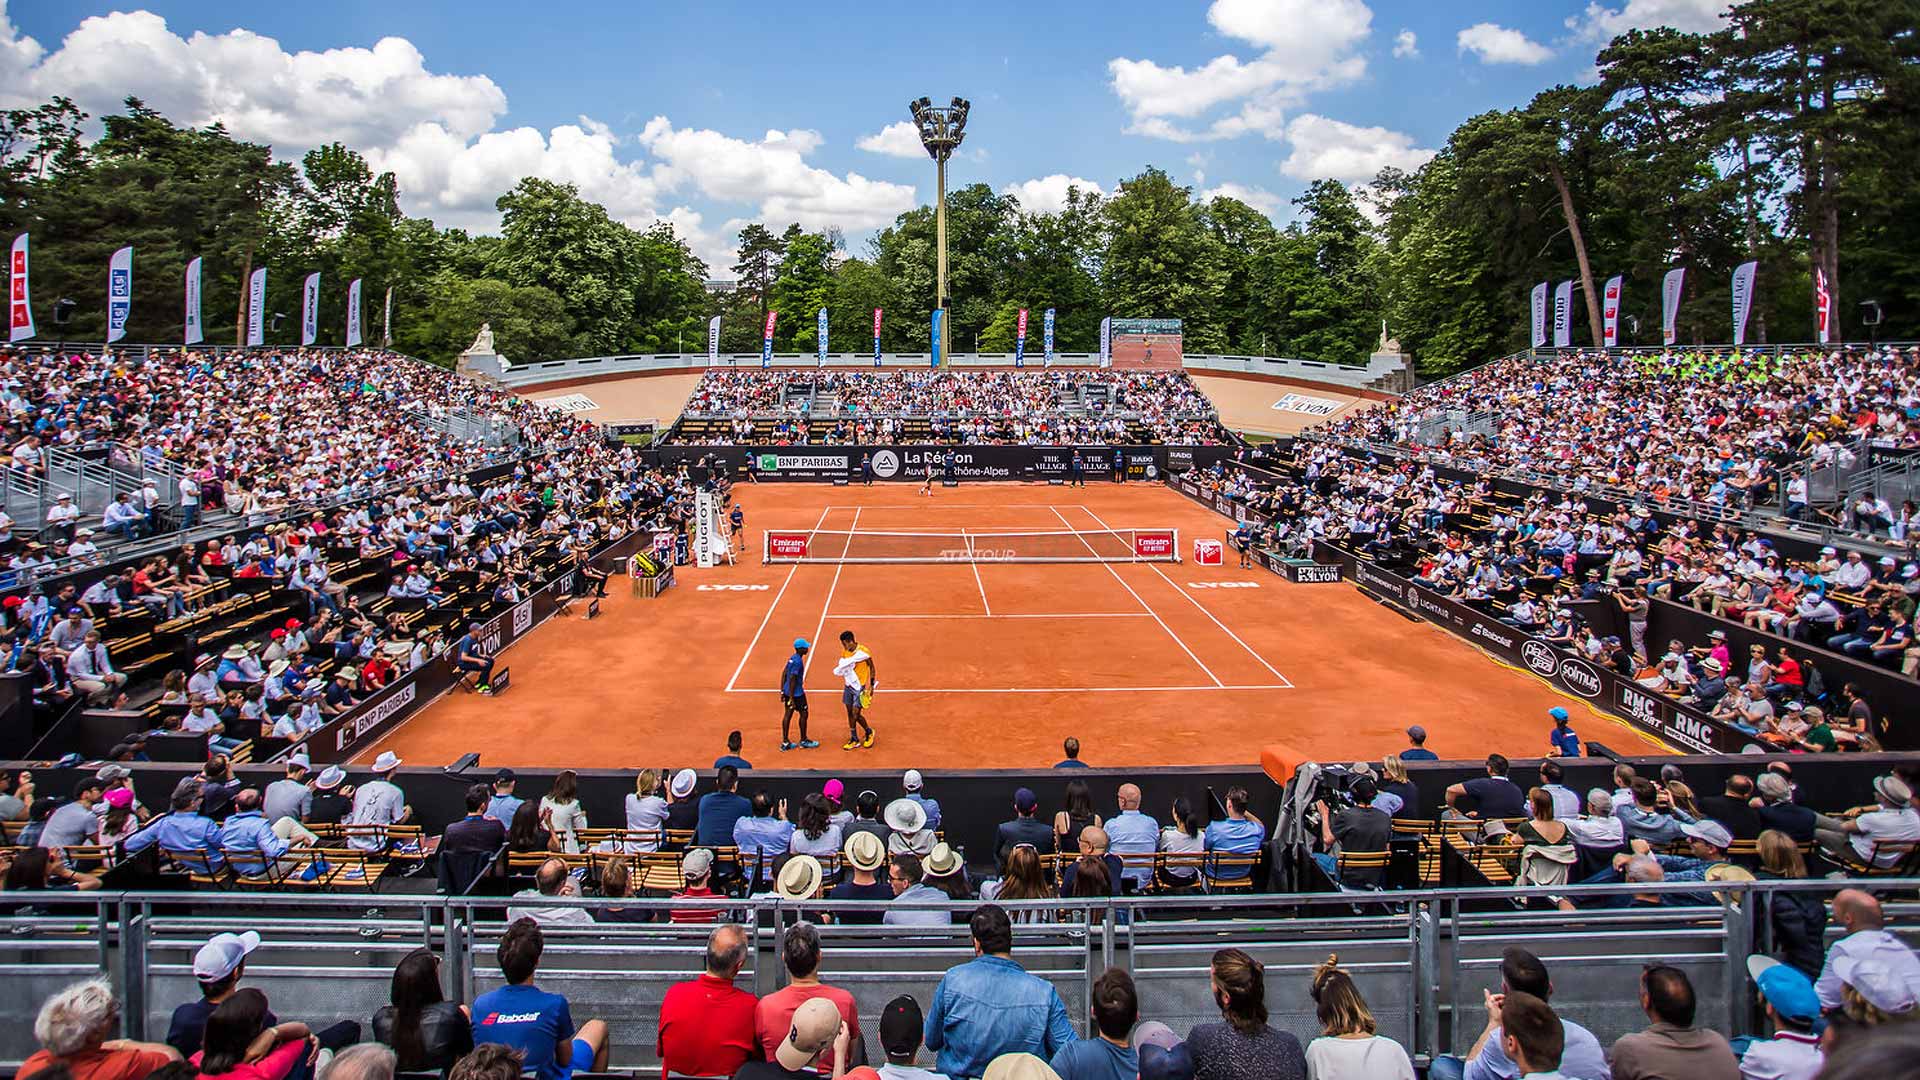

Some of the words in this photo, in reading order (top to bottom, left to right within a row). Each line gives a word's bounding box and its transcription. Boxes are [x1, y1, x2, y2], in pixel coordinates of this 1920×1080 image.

[767, 311, 776, 330] LYON
[1019, 311, 1028, 329] LYON
[1555, 297, 1565, 331] RADO
[1295, 403, 1333, 415] LYON
[779, 458, 799, 467] BNP
[801, 458, 843, 467] PARIBAS
[904, 451, 921, 464] La
[923, 451, 973, 466] Réon
[1043, 455, 1060, 463] THE
[1087, 455, 1103, 463] THE
[701, 500, 710, 562] PEUGEOT
[974, 549, 1017, 561] TOUR
[1314, 572, 1338, 581] LYON
[1482, 627, 1513, 648] Babolat
[358, 710, 377, 732] BNP
[378, 687, 411, 720] PARIBAS
[1623, 688, 1655, 716] RMC
[1631, 705, 1663, 728] SPORT
[1675, 712, 1712, 744] RMC
[497, 1012, 541, 1024] Babolat
